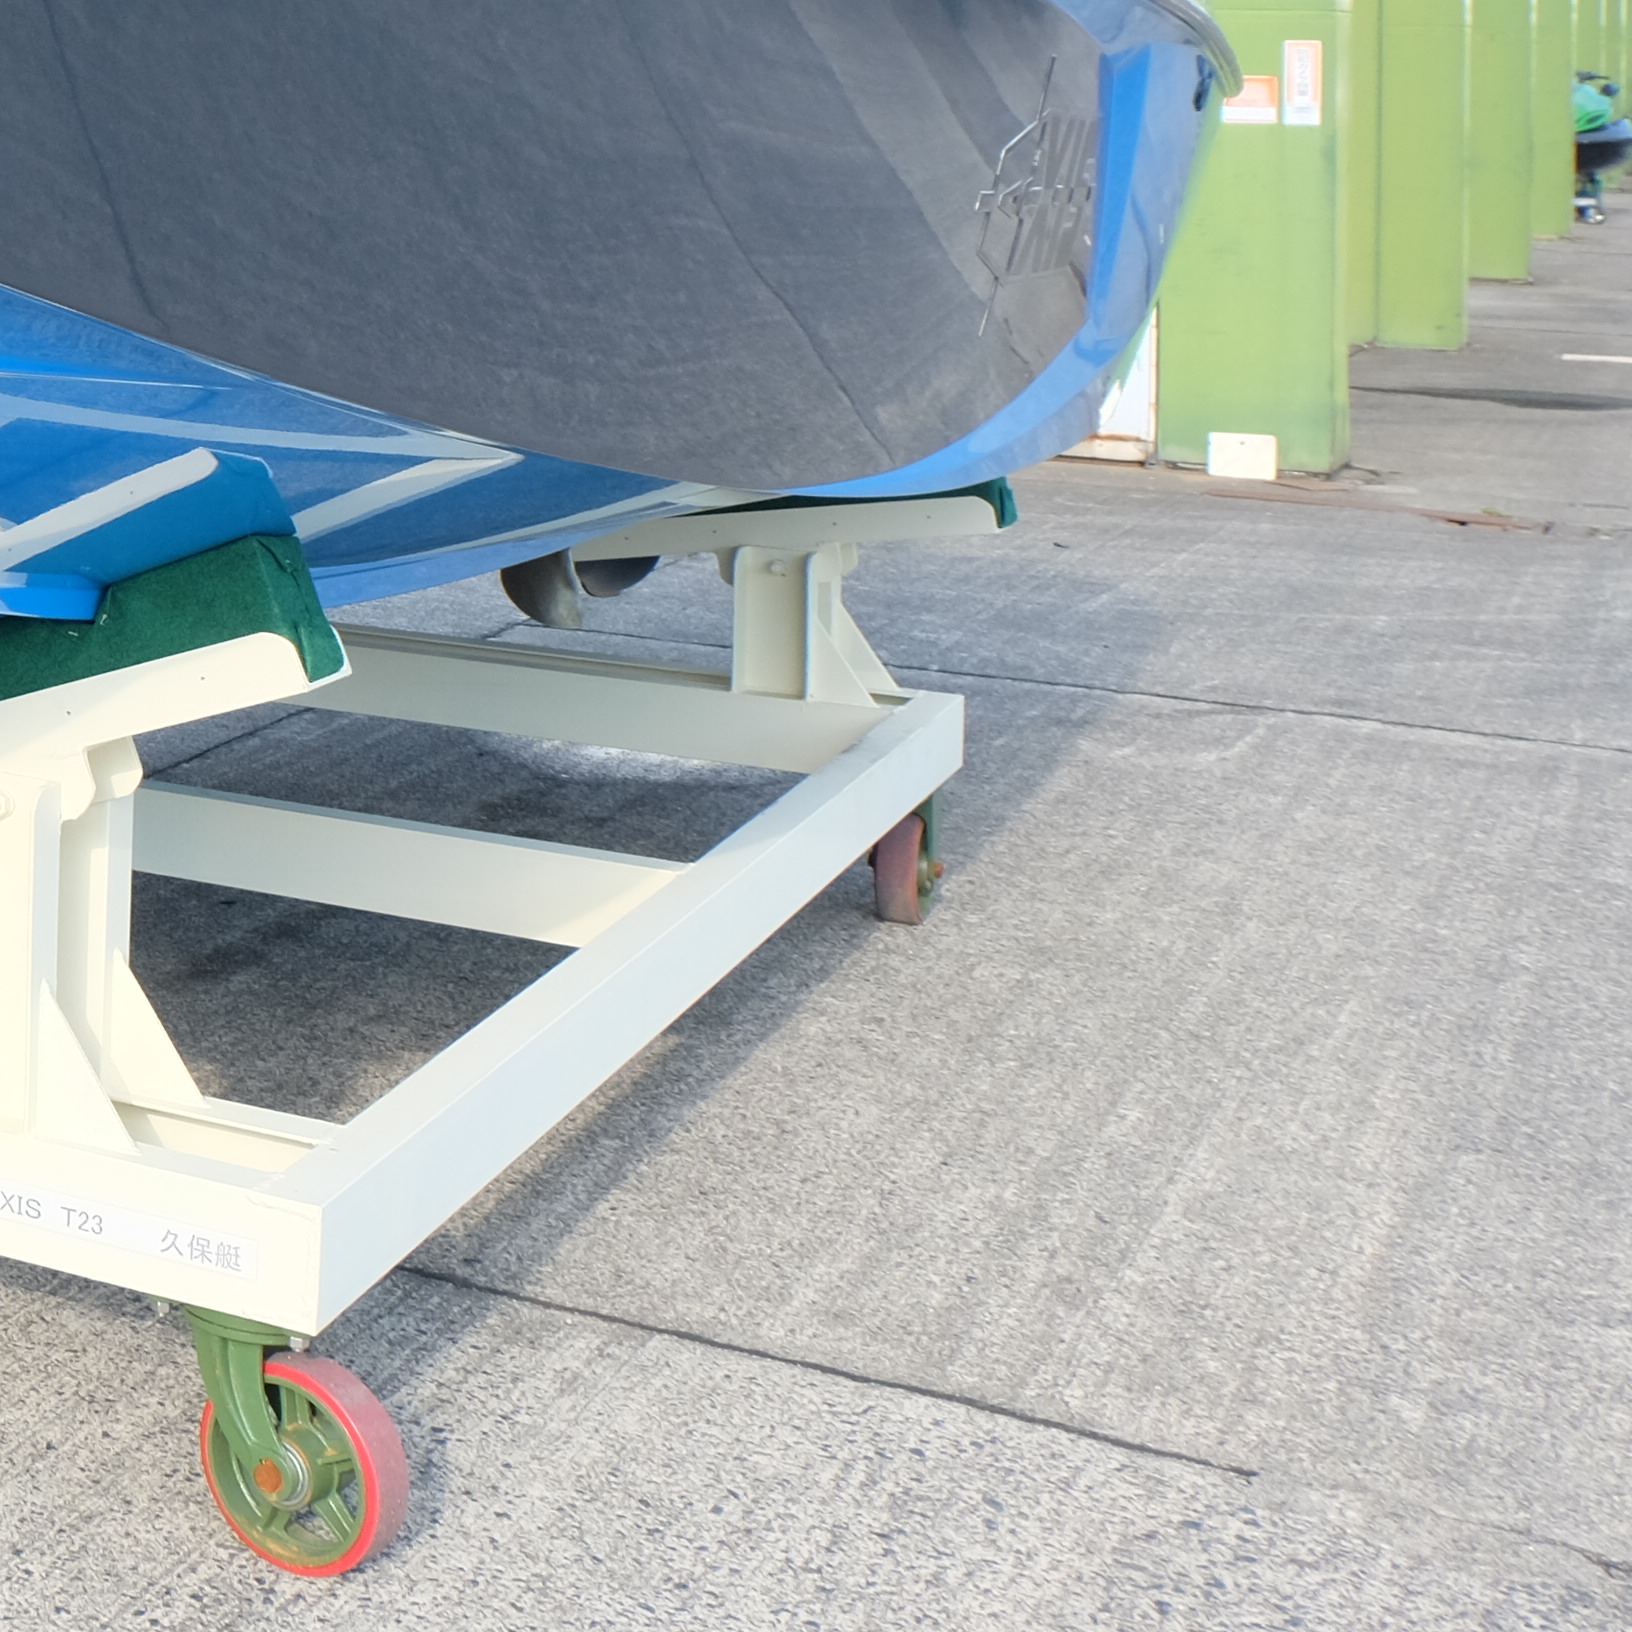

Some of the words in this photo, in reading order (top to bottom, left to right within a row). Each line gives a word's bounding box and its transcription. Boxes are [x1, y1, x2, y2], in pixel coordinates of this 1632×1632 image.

[60, 1206, 104, 1235] T23
[160, 1229, 243, 1273] 久保艇
